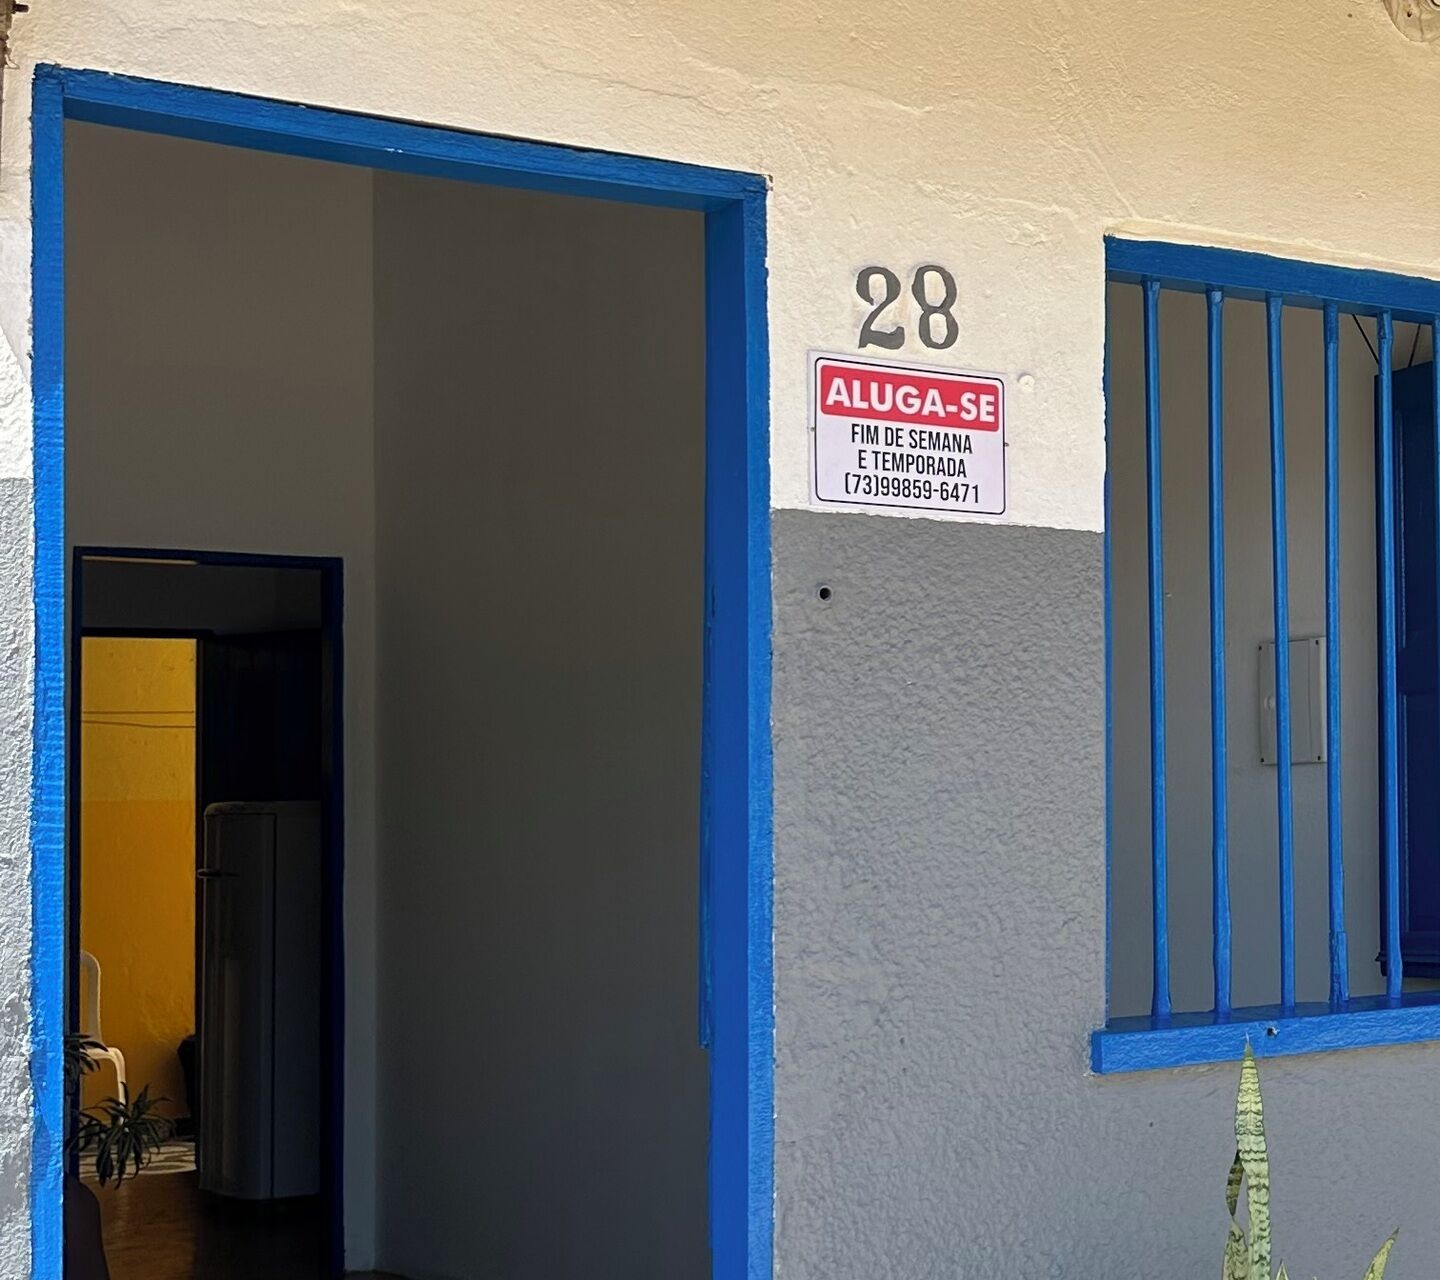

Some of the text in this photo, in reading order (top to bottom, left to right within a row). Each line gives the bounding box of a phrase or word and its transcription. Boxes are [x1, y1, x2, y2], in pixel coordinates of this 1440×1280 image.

[856, 264, 959, 350] 28
[825, 377, 995, 423] ALUGA-SE
[851, 423, 973, 454] FIM DE SEMANA
[858, 449, 967, 478] E TEMPORADA
[845, 472, 979, 504] (73)99859-6471
